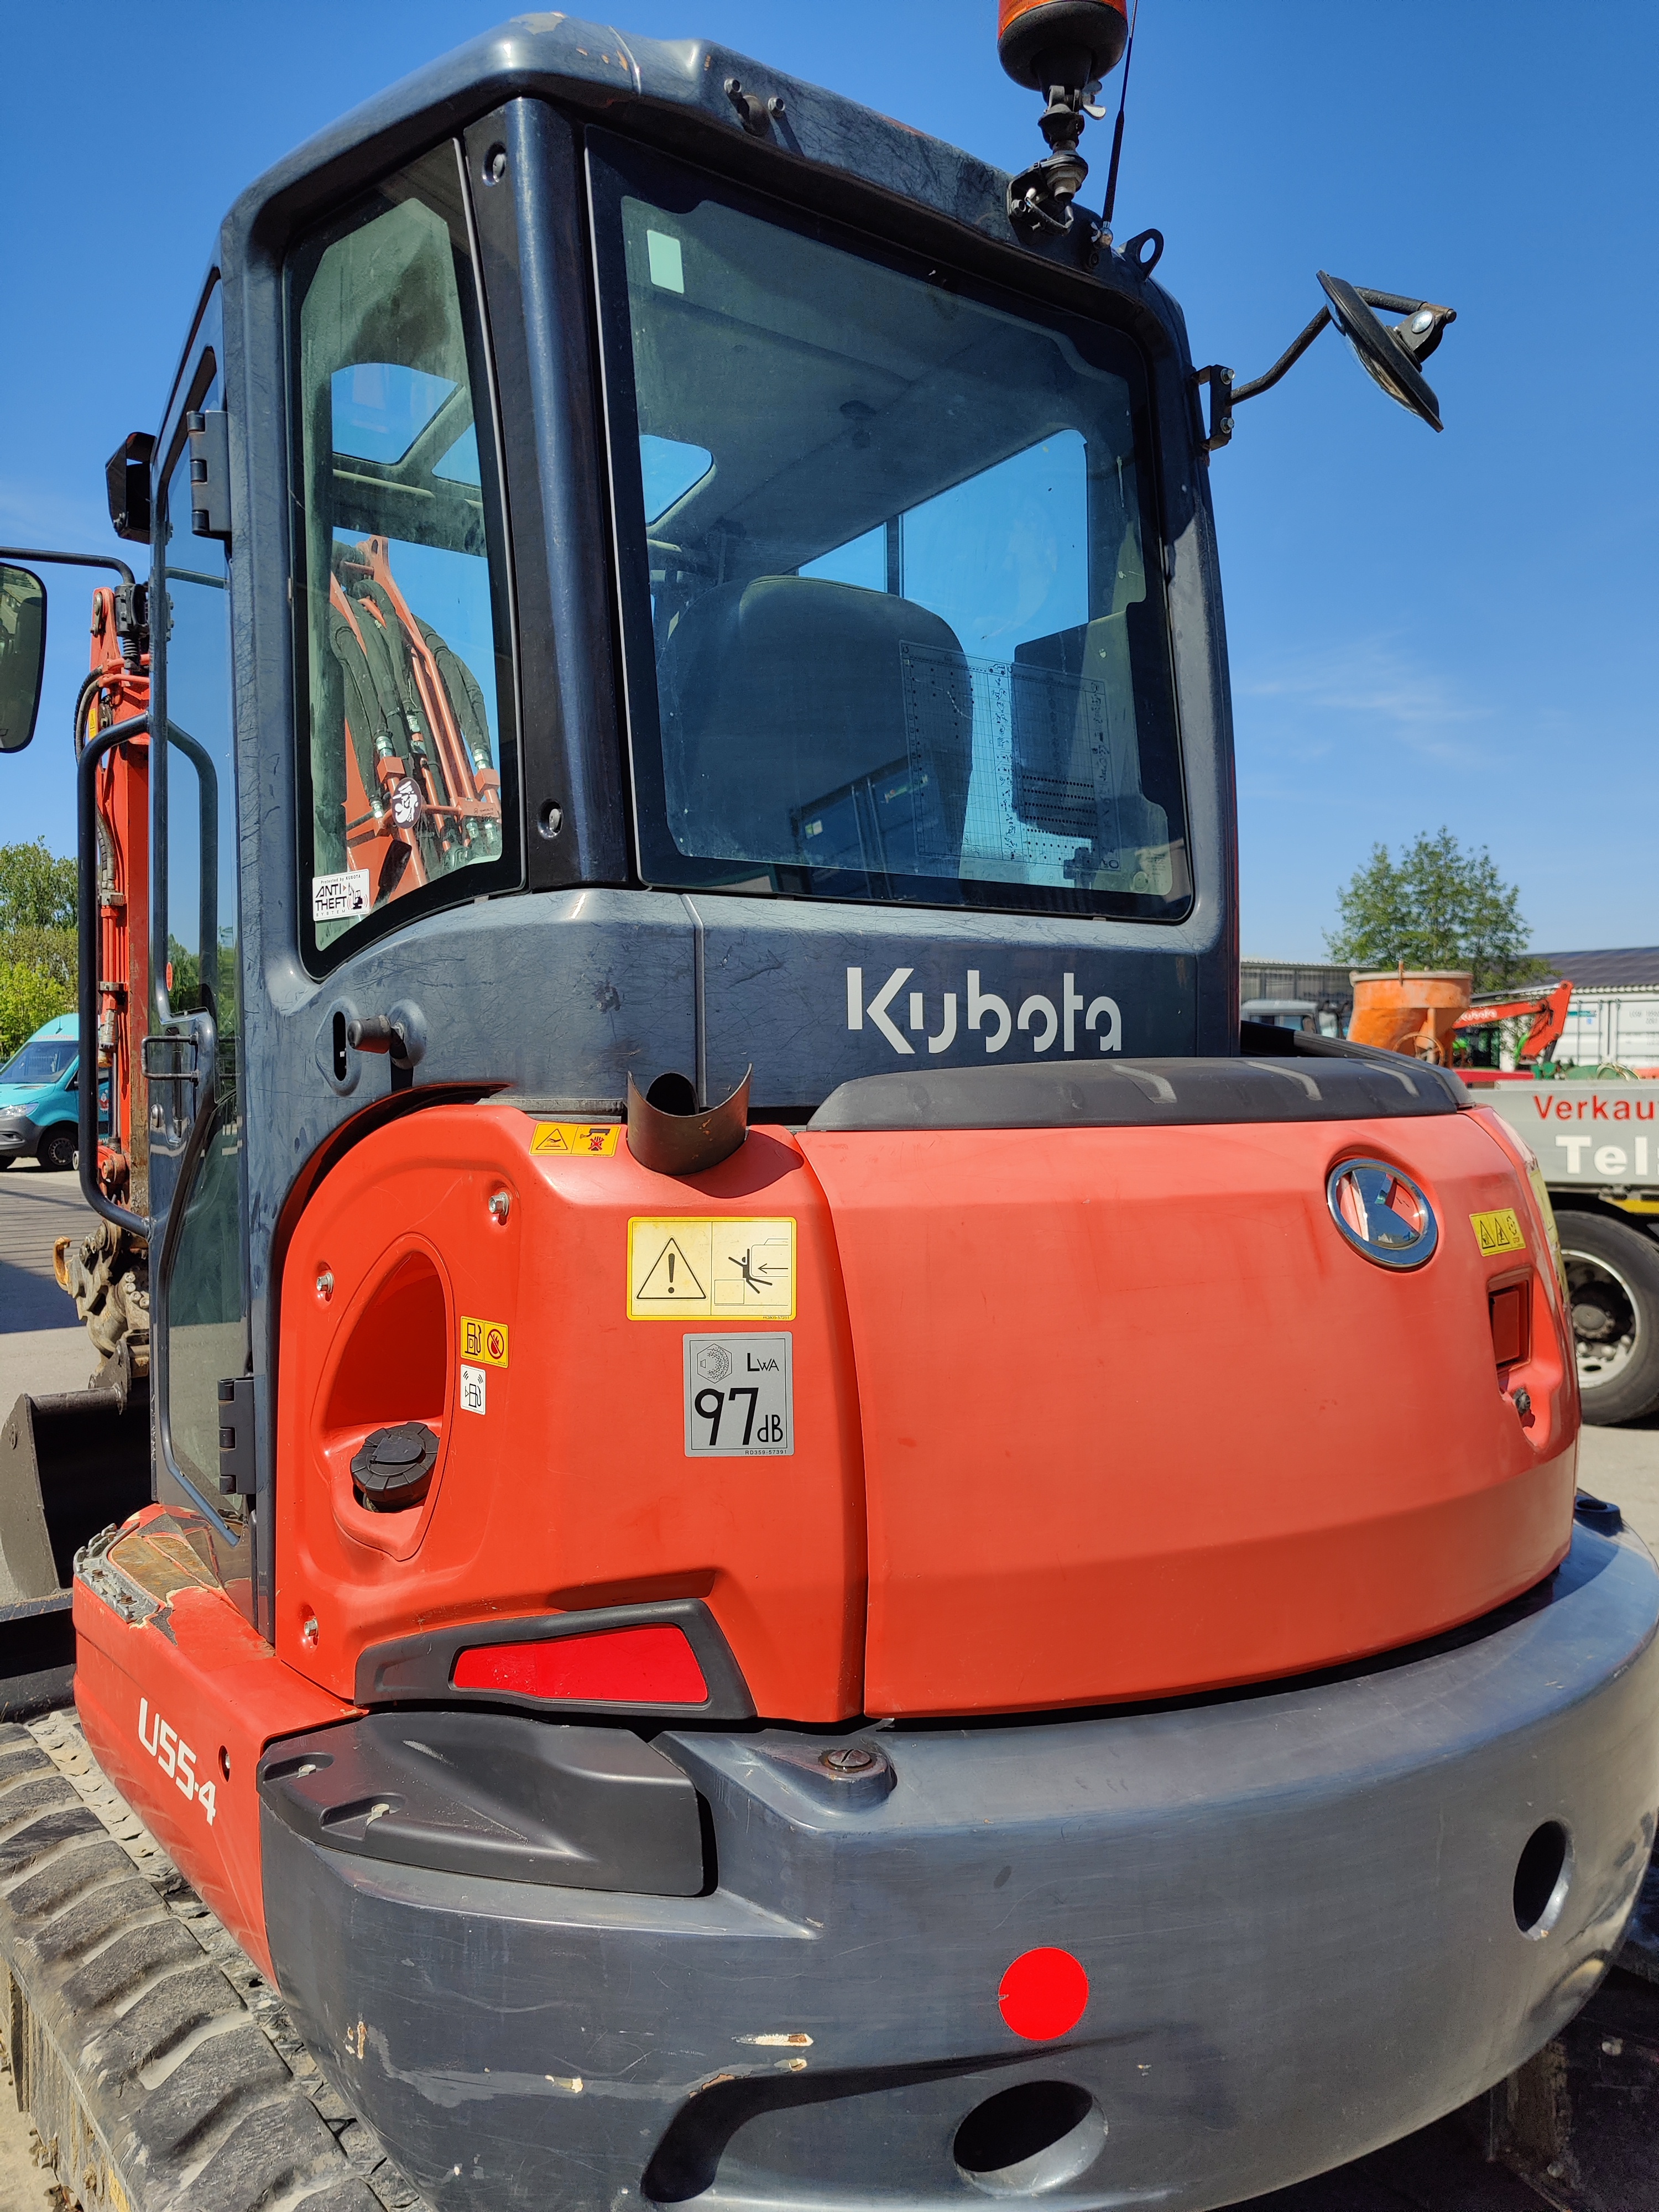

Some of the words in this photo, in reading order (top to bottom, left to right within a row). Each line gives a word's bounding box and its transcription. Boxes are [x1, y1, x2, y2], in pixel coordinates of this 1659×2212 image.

[315, 883, 341, 898] ANTI
[315, 896, 347, 911] THEFT
[847, 967, 1122, 1054] Kubota
[1533, 1094, 1659, 1121] Verkau
[1555, 1135, 1659, 1176] Tel
[695, 1387, 759, 1446] 97
[757, 1414, 784, 1443] dB
